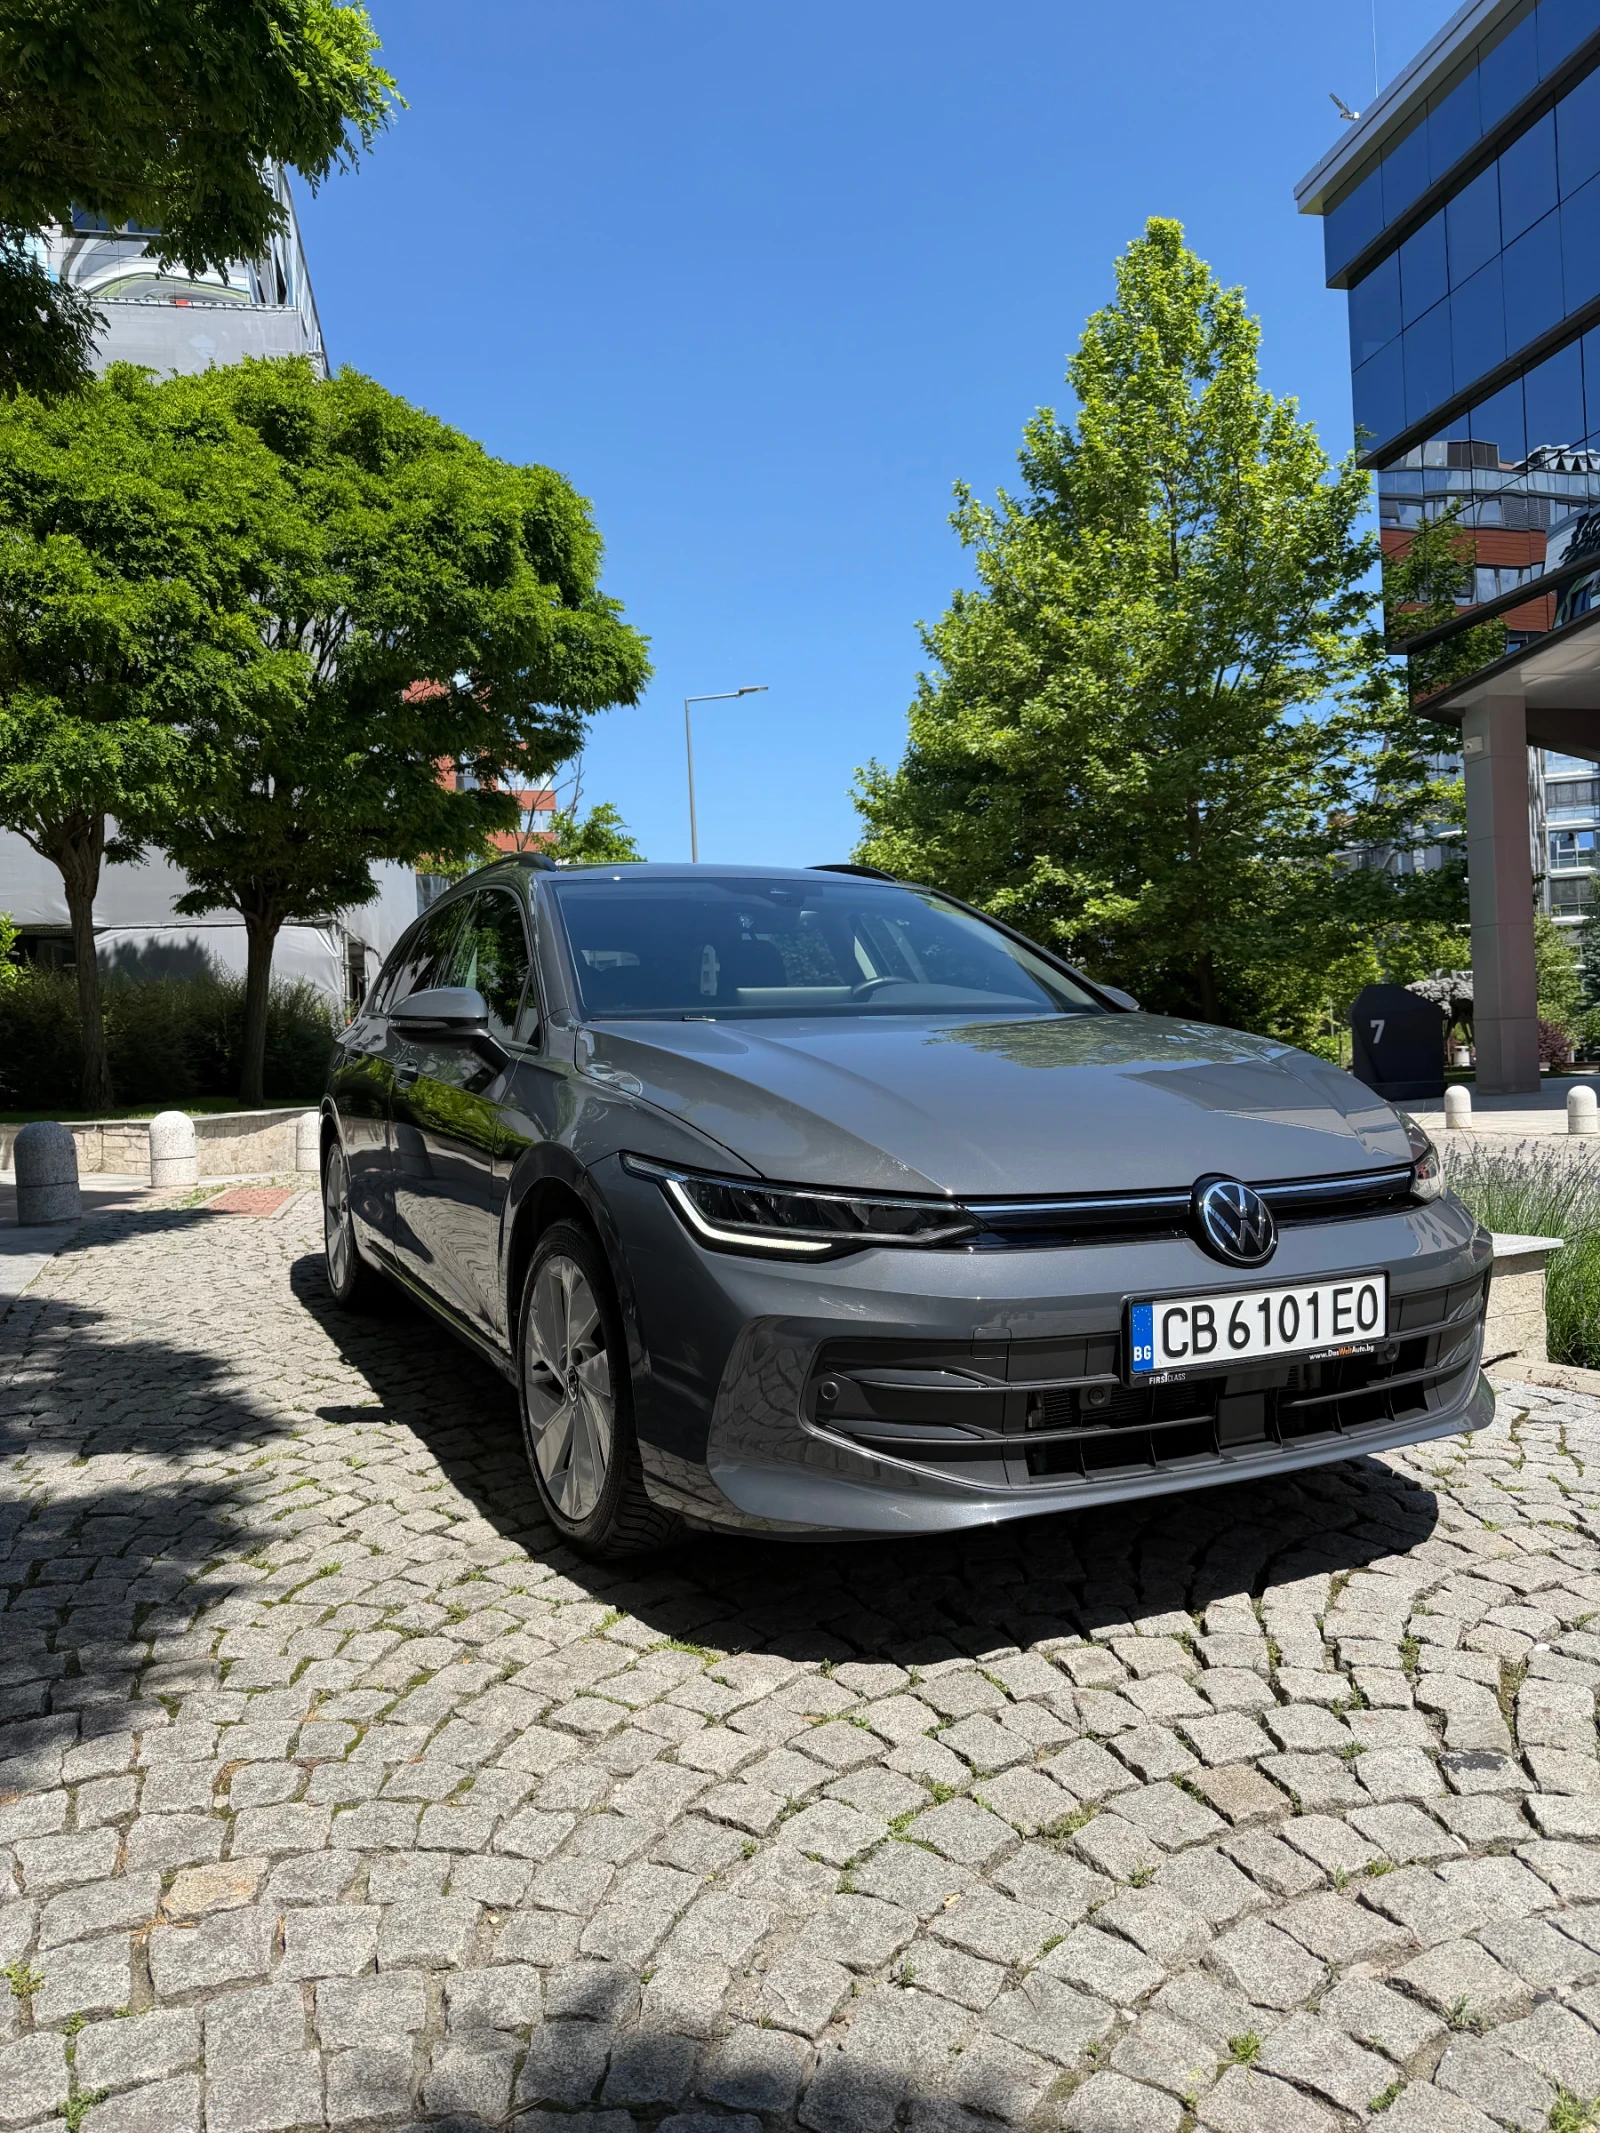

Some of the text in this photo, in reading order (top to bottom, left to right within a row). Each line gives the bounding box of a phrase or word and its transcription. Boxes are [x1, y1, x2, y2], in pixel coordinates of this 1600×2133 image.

[1370, 1019, 1385, 1044] 7
[1133, 1345, 1152, 1362] BG
[1308, 1343, 1375, 1360] www.DasWeltAuto.bg
